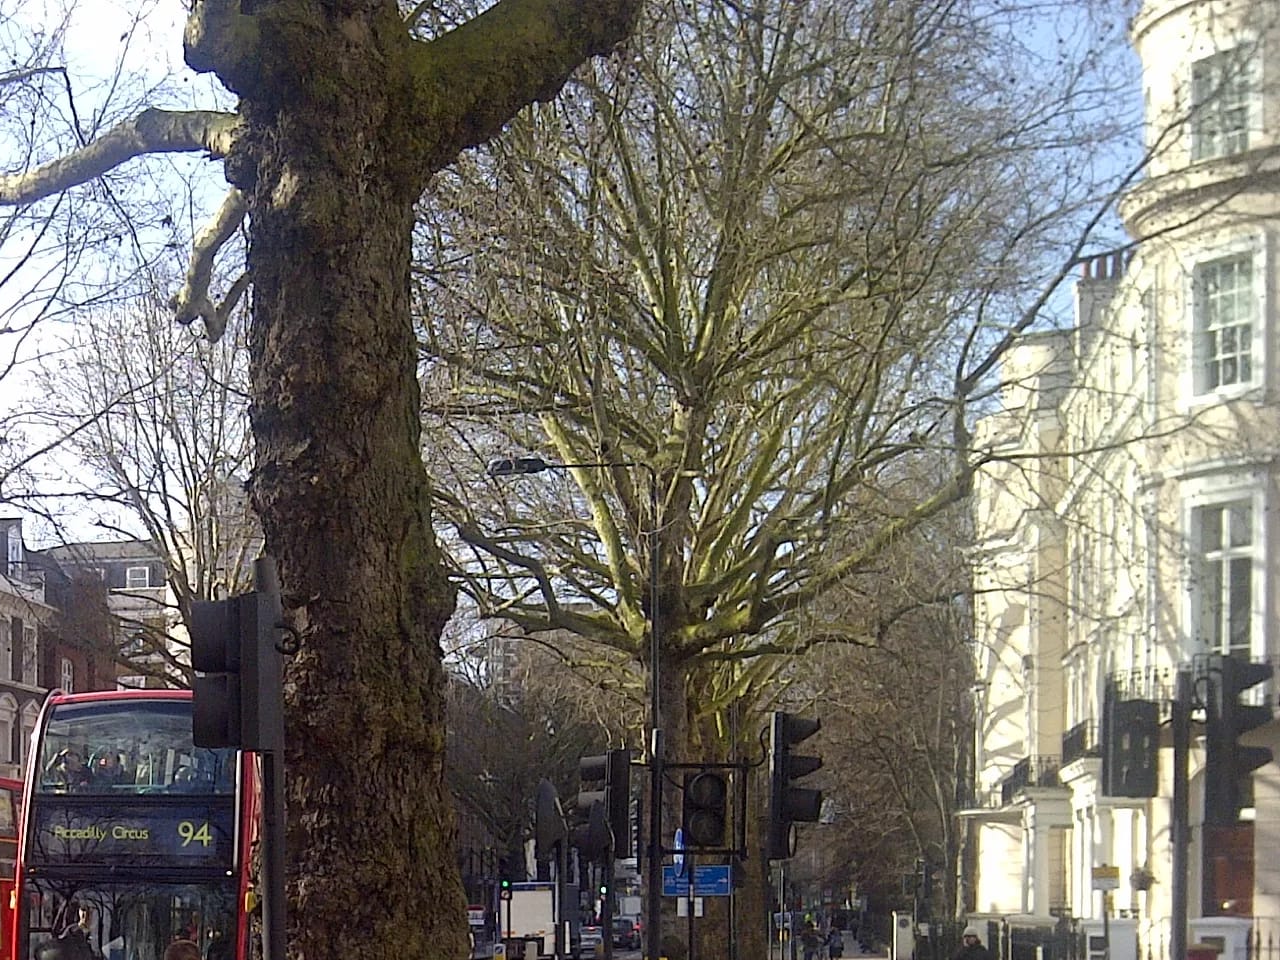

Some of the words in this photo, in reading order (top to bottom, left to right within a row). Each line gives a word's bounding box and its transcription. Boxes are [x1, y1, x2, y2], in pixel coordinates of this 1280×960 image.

[54, 825, 107, 842] Piccadilly
[111, 825, 149, 840] Circus
[177, 821, 213, 848] 94
